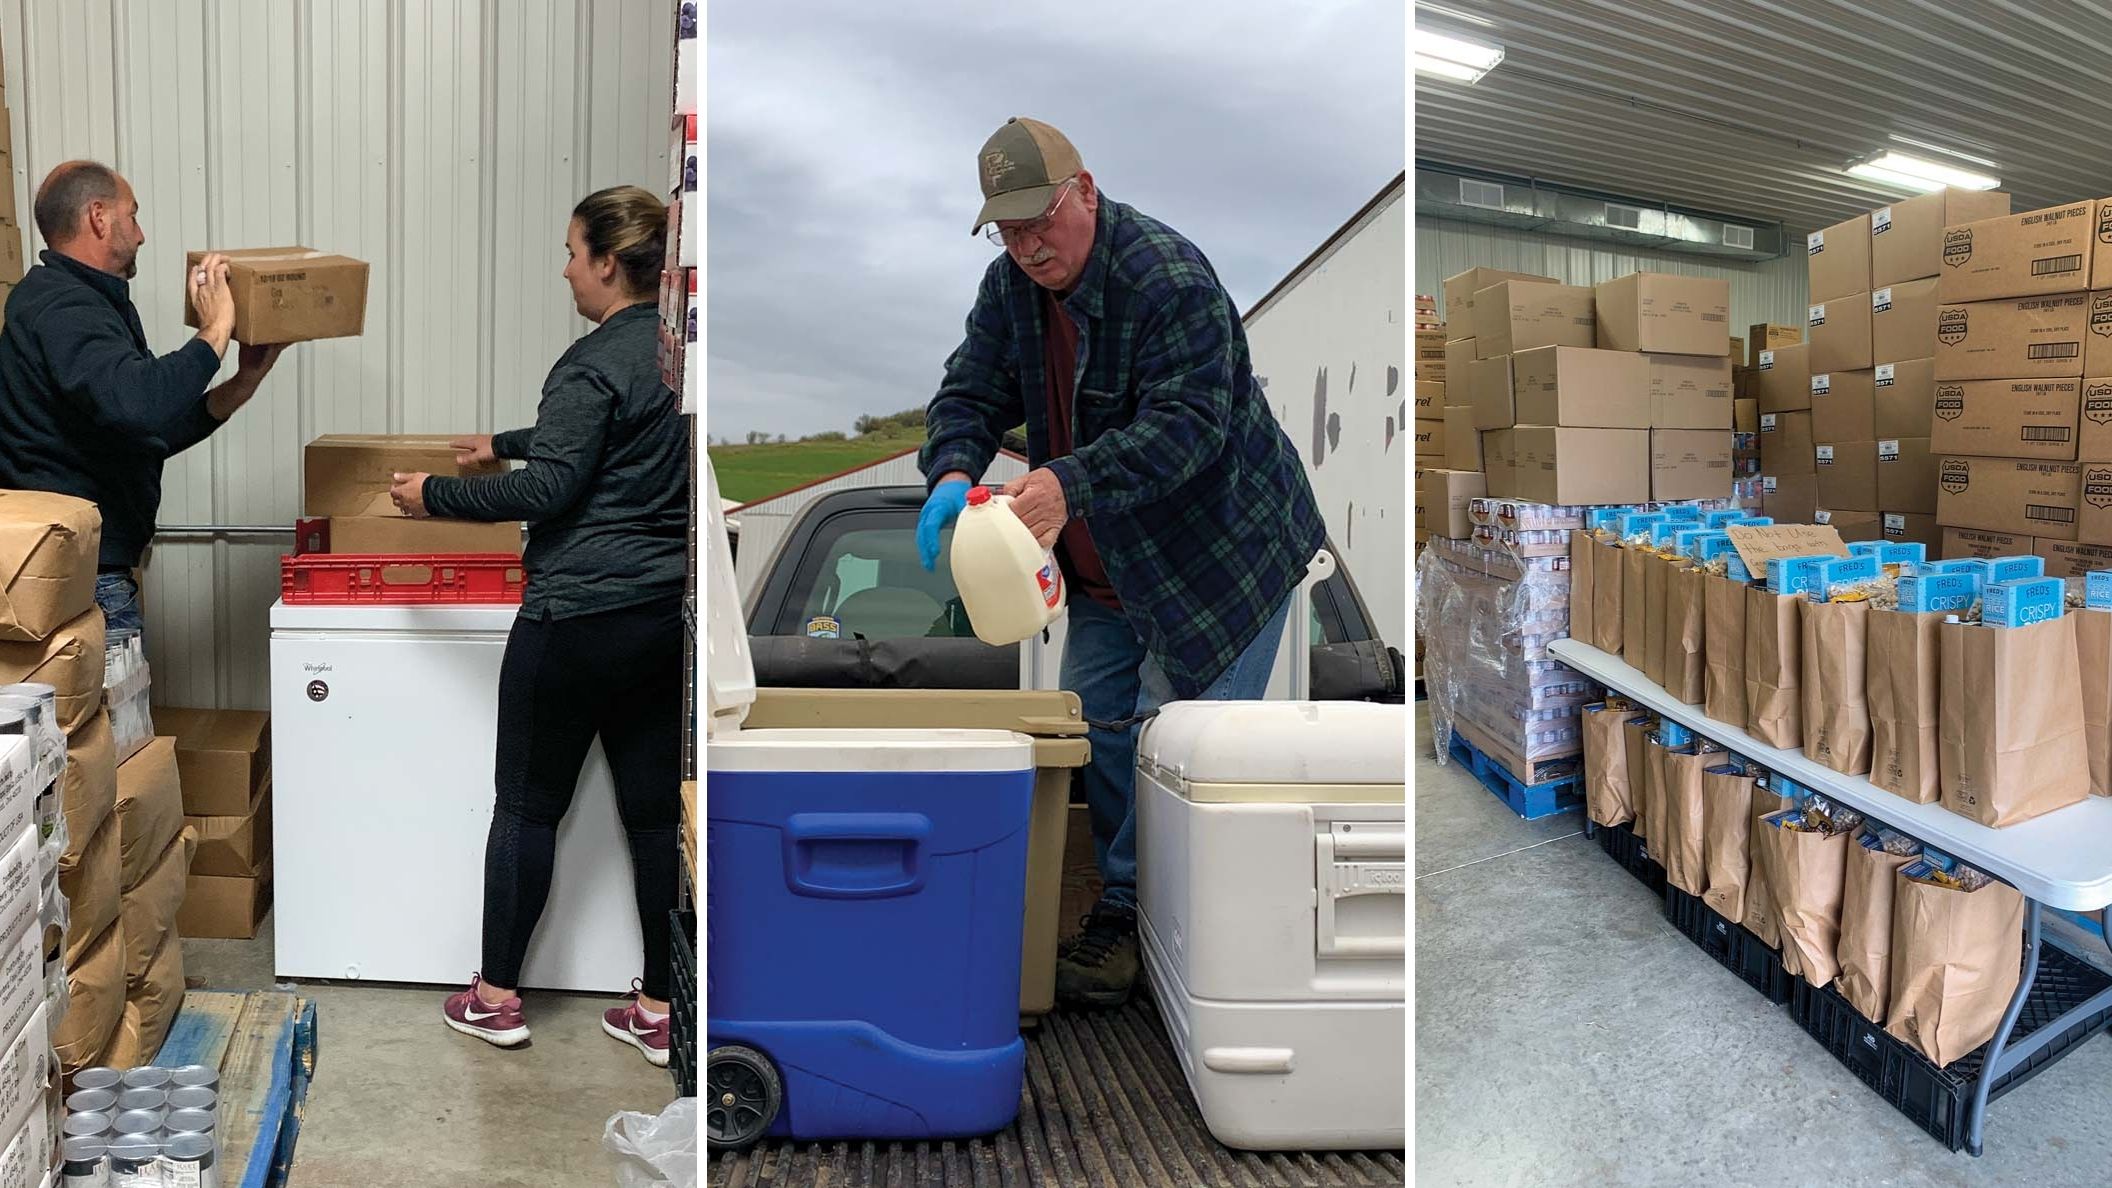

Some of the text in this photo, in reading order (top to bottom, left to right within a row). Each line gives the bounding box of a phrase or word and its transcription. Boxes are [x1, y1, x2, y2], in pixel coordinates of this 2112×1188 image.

[2021, 214, 2042, 226] ENGLISH
[2044, 210, 2066, 222] WALNUT
[2067, 206, 2086, 217] PIECES
[1946, 234, 1970, 242] USDA
[1946, 246, 1970, 254] FOOD
[2018, 297, 2084, 310] ENGLISH WALNUT PIECES
[1942, 313, 1966, 322] USDA
[1940, 325, 1965, 333] FOOD
[2012, 384, 2074, 392] ENGLISH WALNUT PIECES
[2017, 463, 2080, 474] ENGLISH WALNUT PIECES
[1732, 528, 1817, 540] Do Not Use
[1958, 532, 2013, 545] ENGLISH WALNUT PIECES
[1741, 543, 1768, 554] the
[1889, 548, 1911, 556] FRED'S
[2053, 544, 2074, 552] ENGLISH
[2076, 546, 2097, 556] WALNUT
[1838, 562, 1865, 574] FRED'S
[2004, 564, 2029, 574] FRED'S
[1792, 577, 1808, 589] CR
[1936, 578, 1962, 589] FRED'S
[2026, 586, 2050, 598] FRED'S
[2091, 591, 2110, 599] RICE
[1930, 594, 1969, 611] CRISPY
[1986, 605, 2004, 614] RICE
[2020, 602, 2056, 622] CRISPY
[303, 662, 332, 675] Whirlpool
[1371, 870, 1401, 885] igloo
